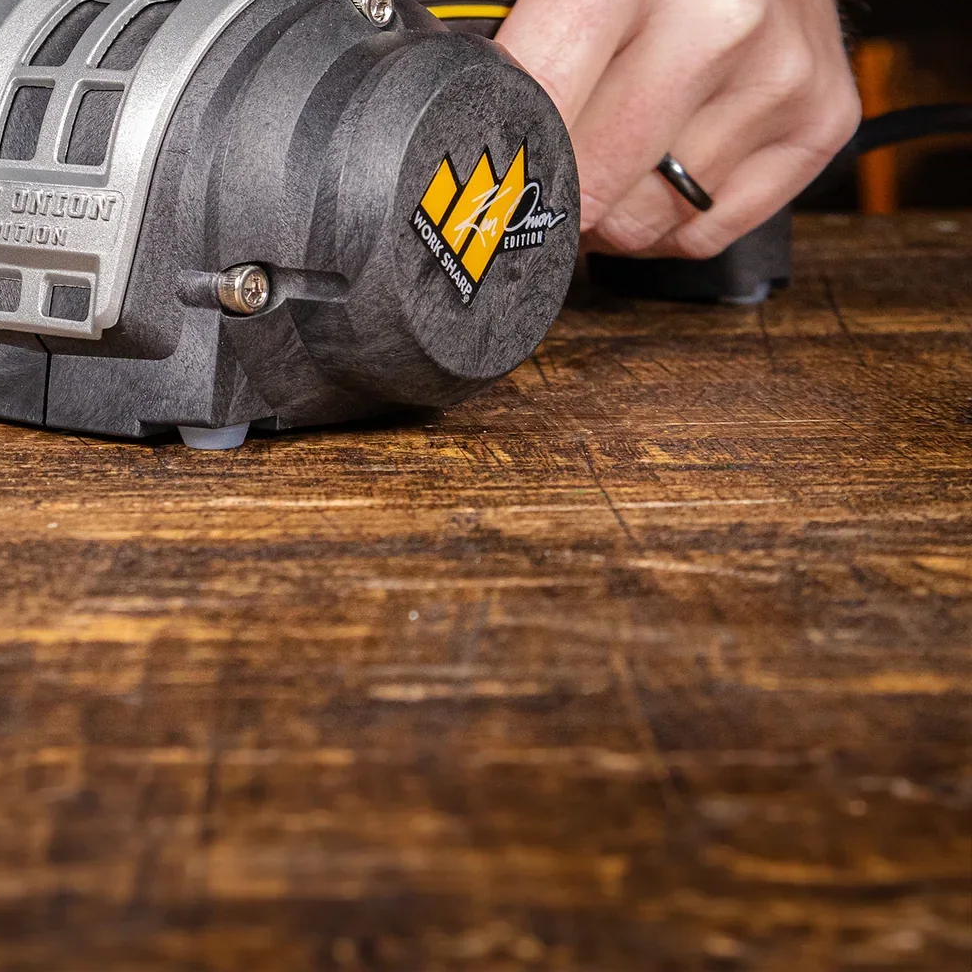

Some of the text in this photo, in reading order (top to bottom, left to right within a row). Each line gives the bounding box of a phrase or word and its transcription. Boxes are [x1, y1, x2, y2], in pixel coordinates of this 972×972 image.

[11, 187, 116, 221] ONION
[453, 182, 566, 247] Ken Onion
[413, 211, 444, 258] WORK
[503, 231, 544, 249] EDITION
